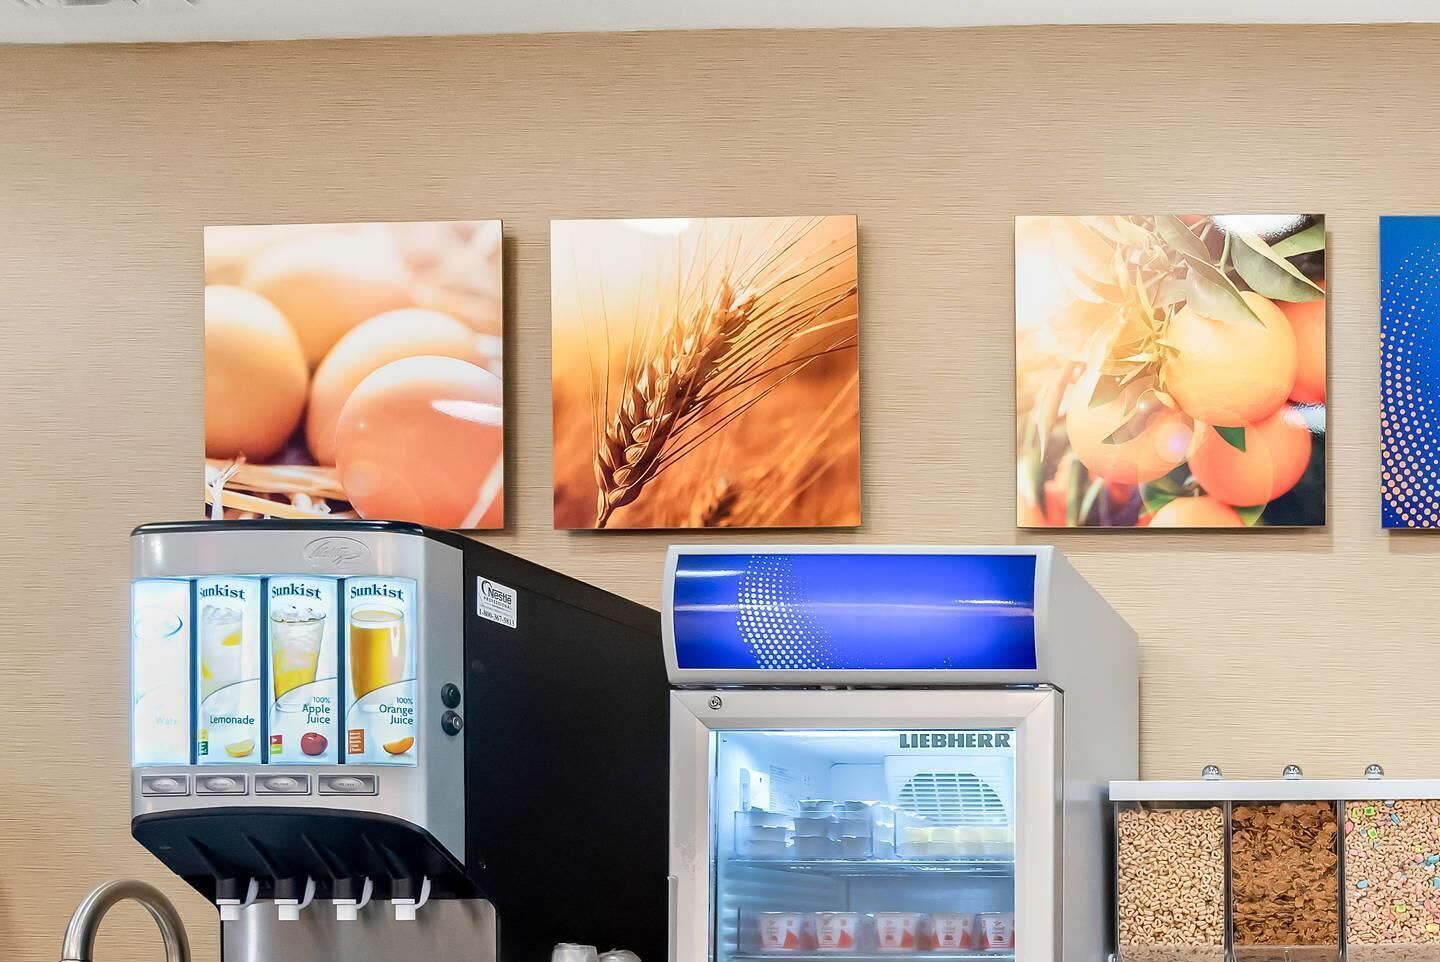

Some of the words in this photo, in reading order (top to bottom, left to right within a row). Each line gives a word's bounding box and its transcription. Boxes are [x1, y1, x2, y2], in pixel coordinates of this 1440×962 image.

[199, 584, 246, 601] Sunkist
[271, 583, 322, 600] Sunkist
[350, 583, 404, 601] Sunkist
[312, 696, 331, 704] 100%
[396, 696, 414, 705] 100%
[302, 704, 331, 716] Apple
[379, 704, 414, 717] Orange
[209, 715, 255, 726] Lemonade
[306, 713, 331, 725] Juice
[390, 714, 414, 725] Juice
[899, 733, 1011, 748] LIEBHERR
